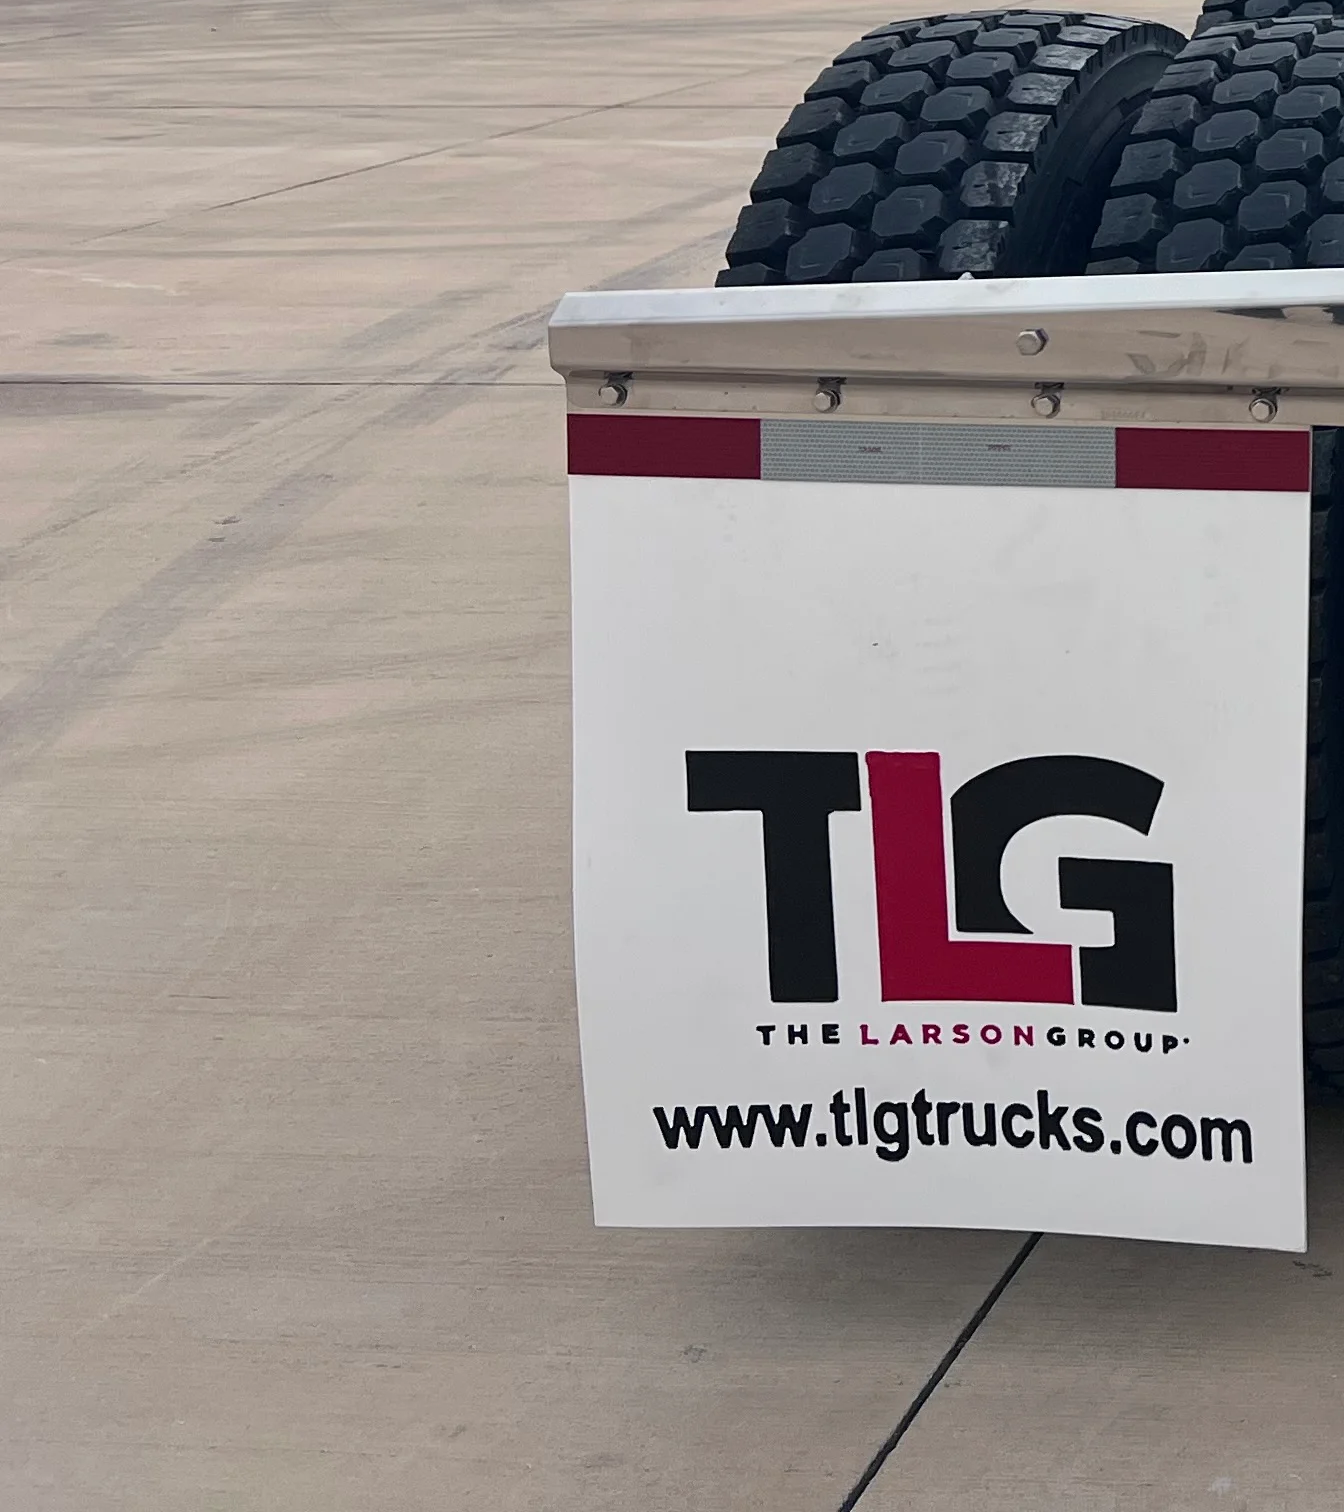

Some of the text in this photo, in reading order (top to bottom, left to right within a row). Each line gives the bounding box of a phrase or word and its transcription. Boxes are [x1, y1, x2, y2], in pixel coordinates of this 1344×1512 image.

[685, 750, 1178, 1013] TLG
[755, 1024, 841, 1046] THE
[652, 1087, 1254, 1164] www.tlgtrucks.com
